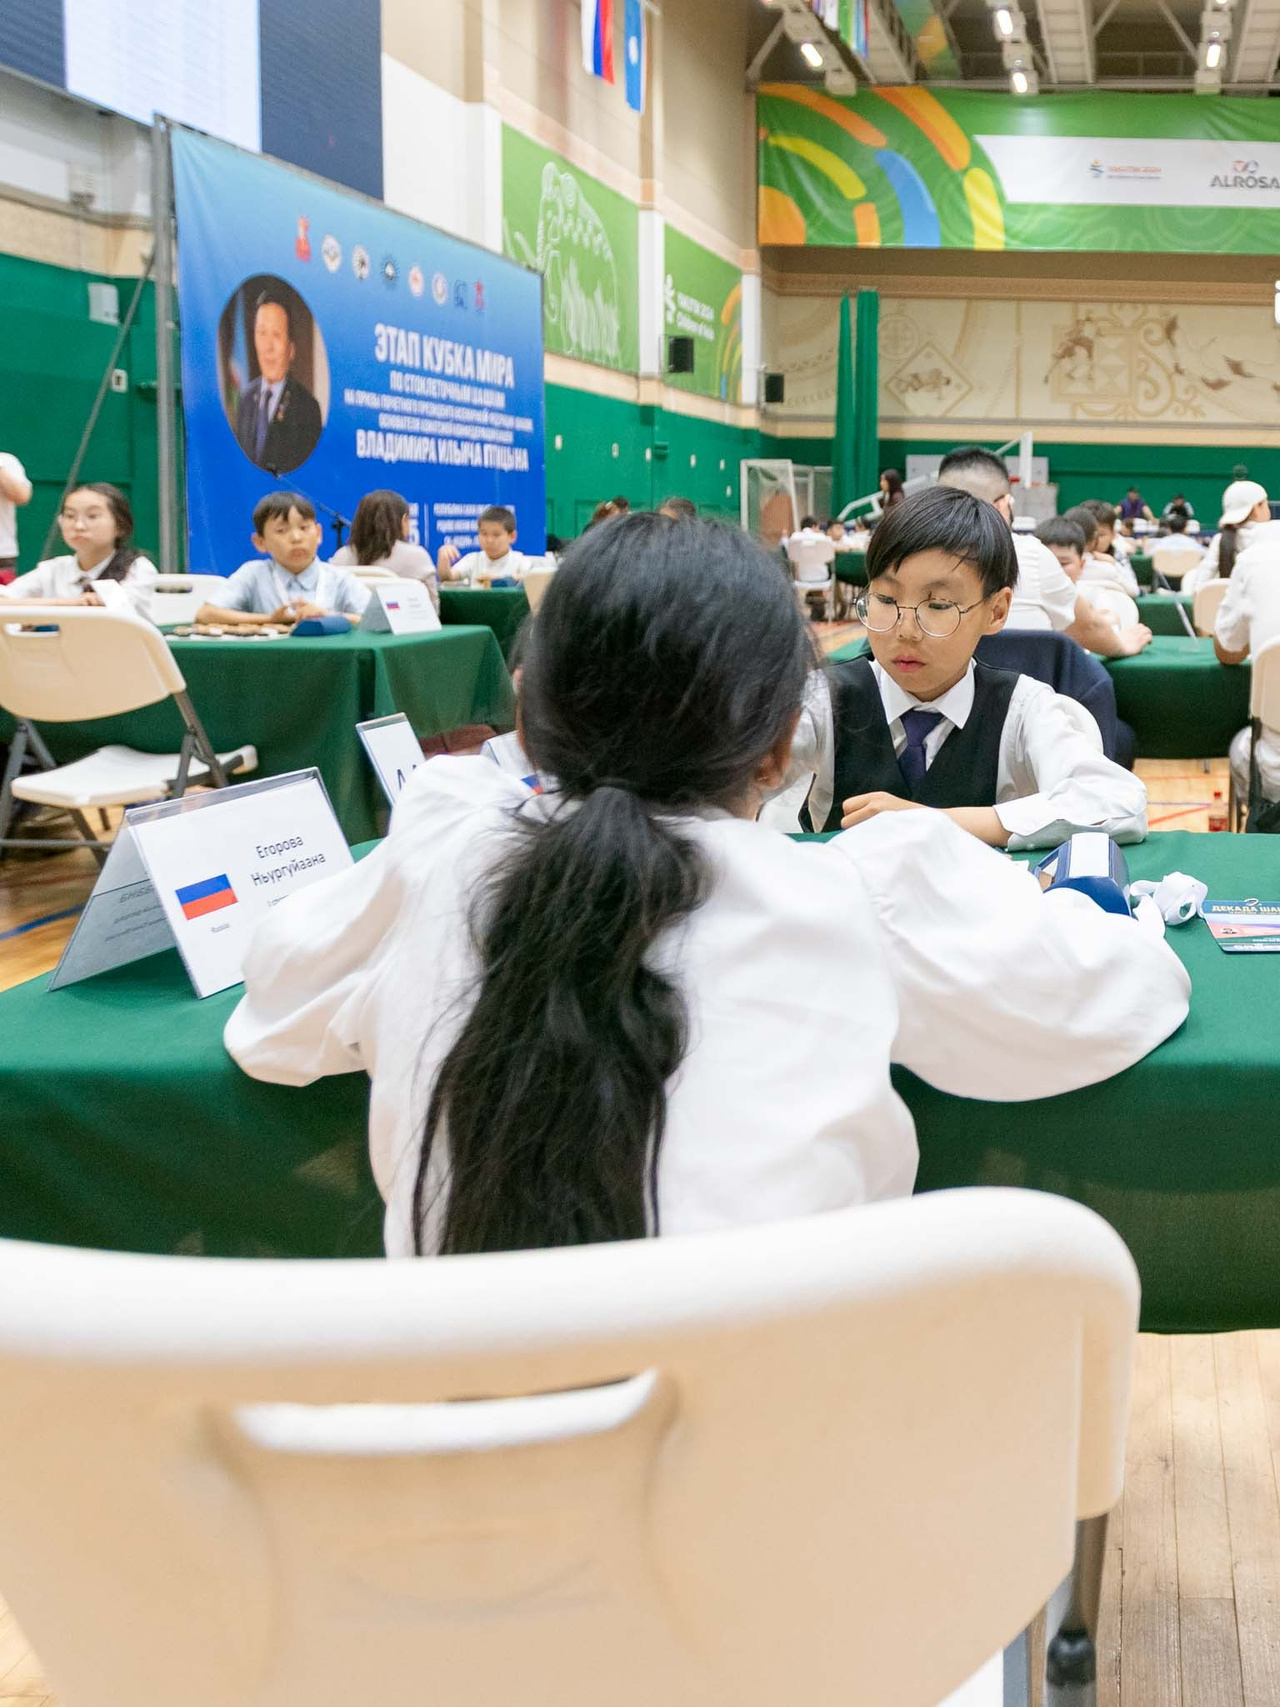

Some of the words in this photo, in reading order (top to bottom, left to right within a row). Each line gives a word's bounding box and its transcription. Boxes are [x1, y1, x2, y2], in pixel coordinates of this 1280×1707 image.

[1210, 175, 1280, 189] ALROSA
[374, 322, 420, 369] ЭТАП
[422, 334, 475, 381] КУБКА
[475, 348, 515, 389] МИРА
[390, 370, 403, 391] ПО
[356, 428, 437, 464] ВЛАДИМИРА
[437, 438, 482, 468] ИЛЬИЧА
[483, 443, 529, 472] ПТИЦЫНА
[255, 834, 304, 860] Егорова
[250, 851, 326, 887] Ньургуйаана
